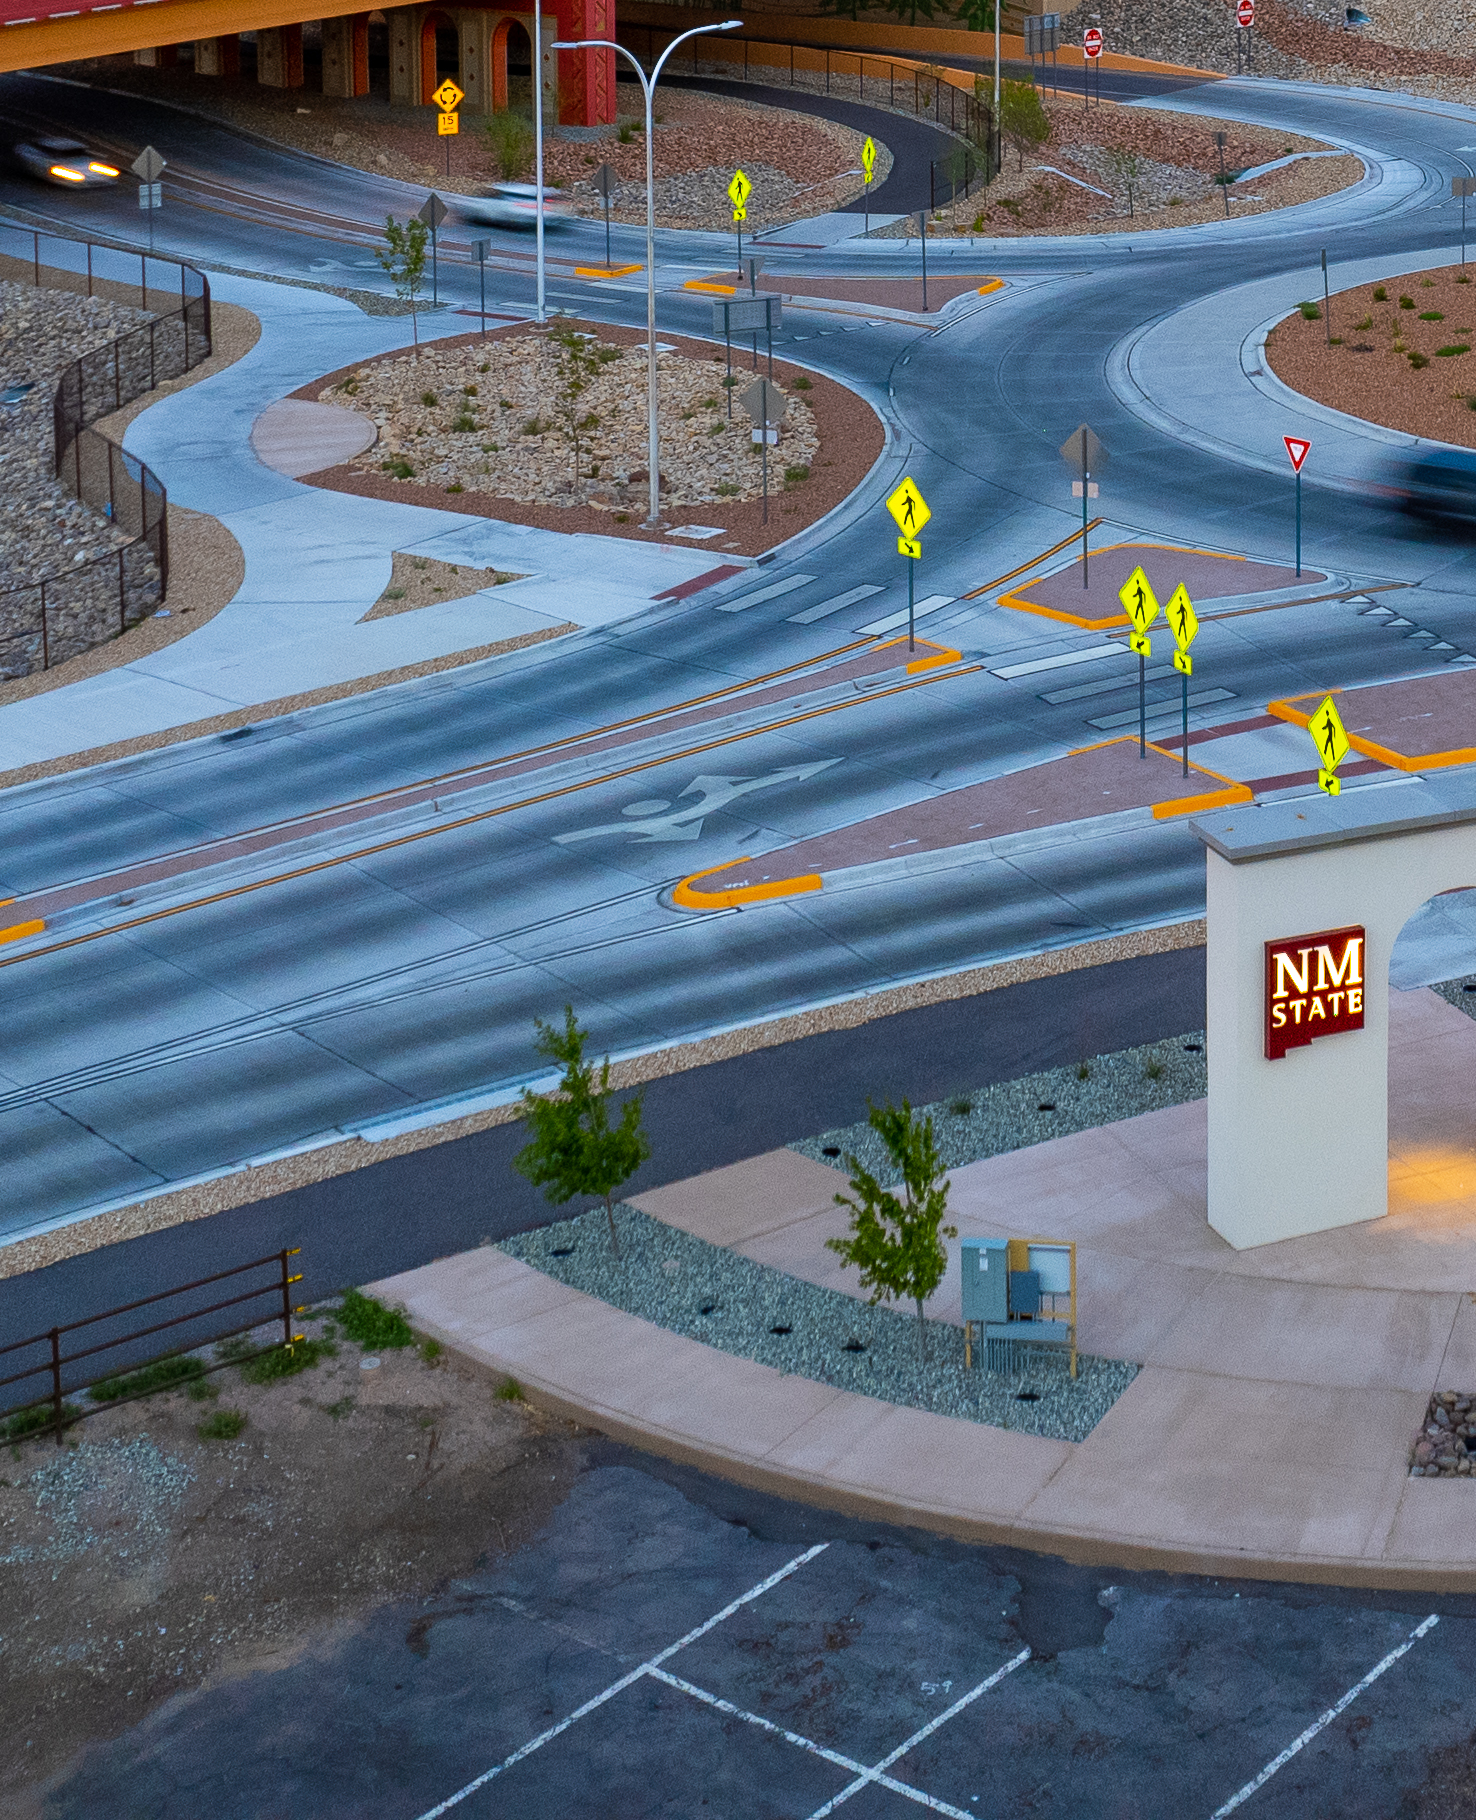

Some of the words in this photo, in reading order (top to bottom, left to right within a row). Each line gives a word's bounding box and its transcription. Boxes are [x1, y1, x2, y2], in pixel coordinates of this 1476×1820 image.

[442, 115, 454, 125] 15
[1272, 937, 1364, 1000] NM
[1272, 988, 1363, 1029] STATE
